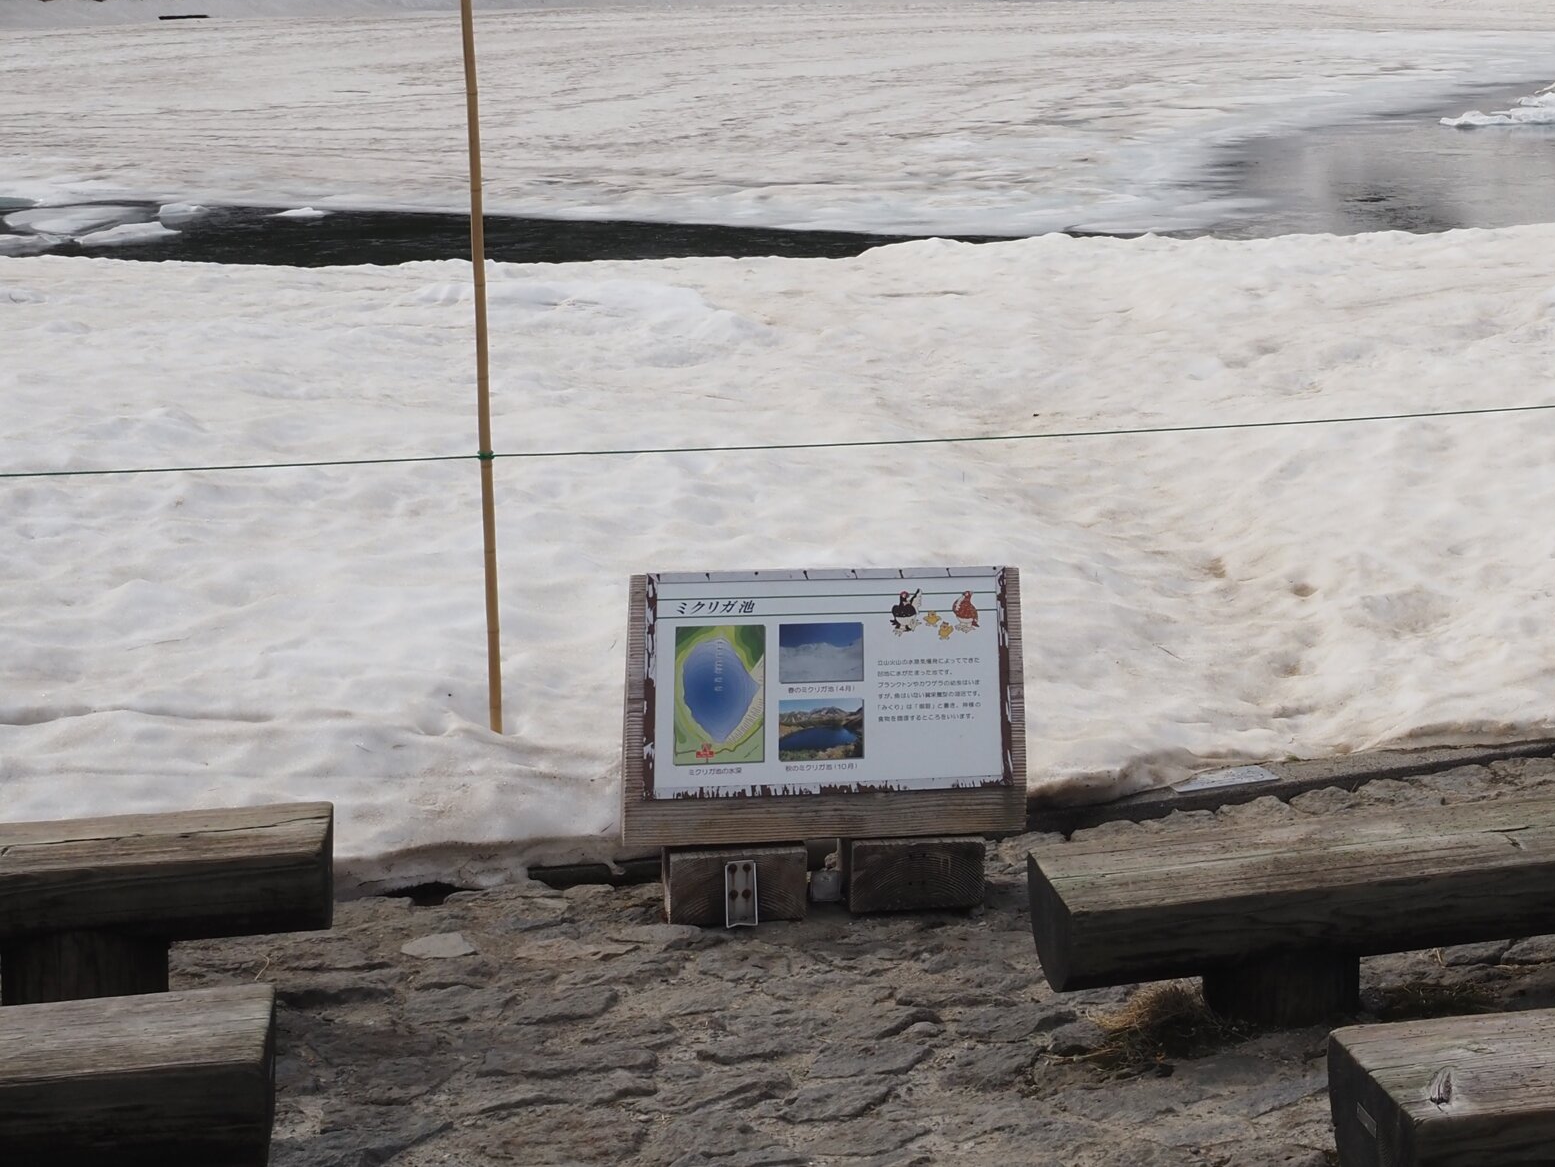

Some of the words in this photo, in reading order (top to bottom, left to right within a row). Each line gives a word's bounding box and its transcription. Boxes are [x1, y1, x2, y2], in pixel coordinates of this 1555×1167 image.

[676, 599, 755, 615] ミクリガ池
